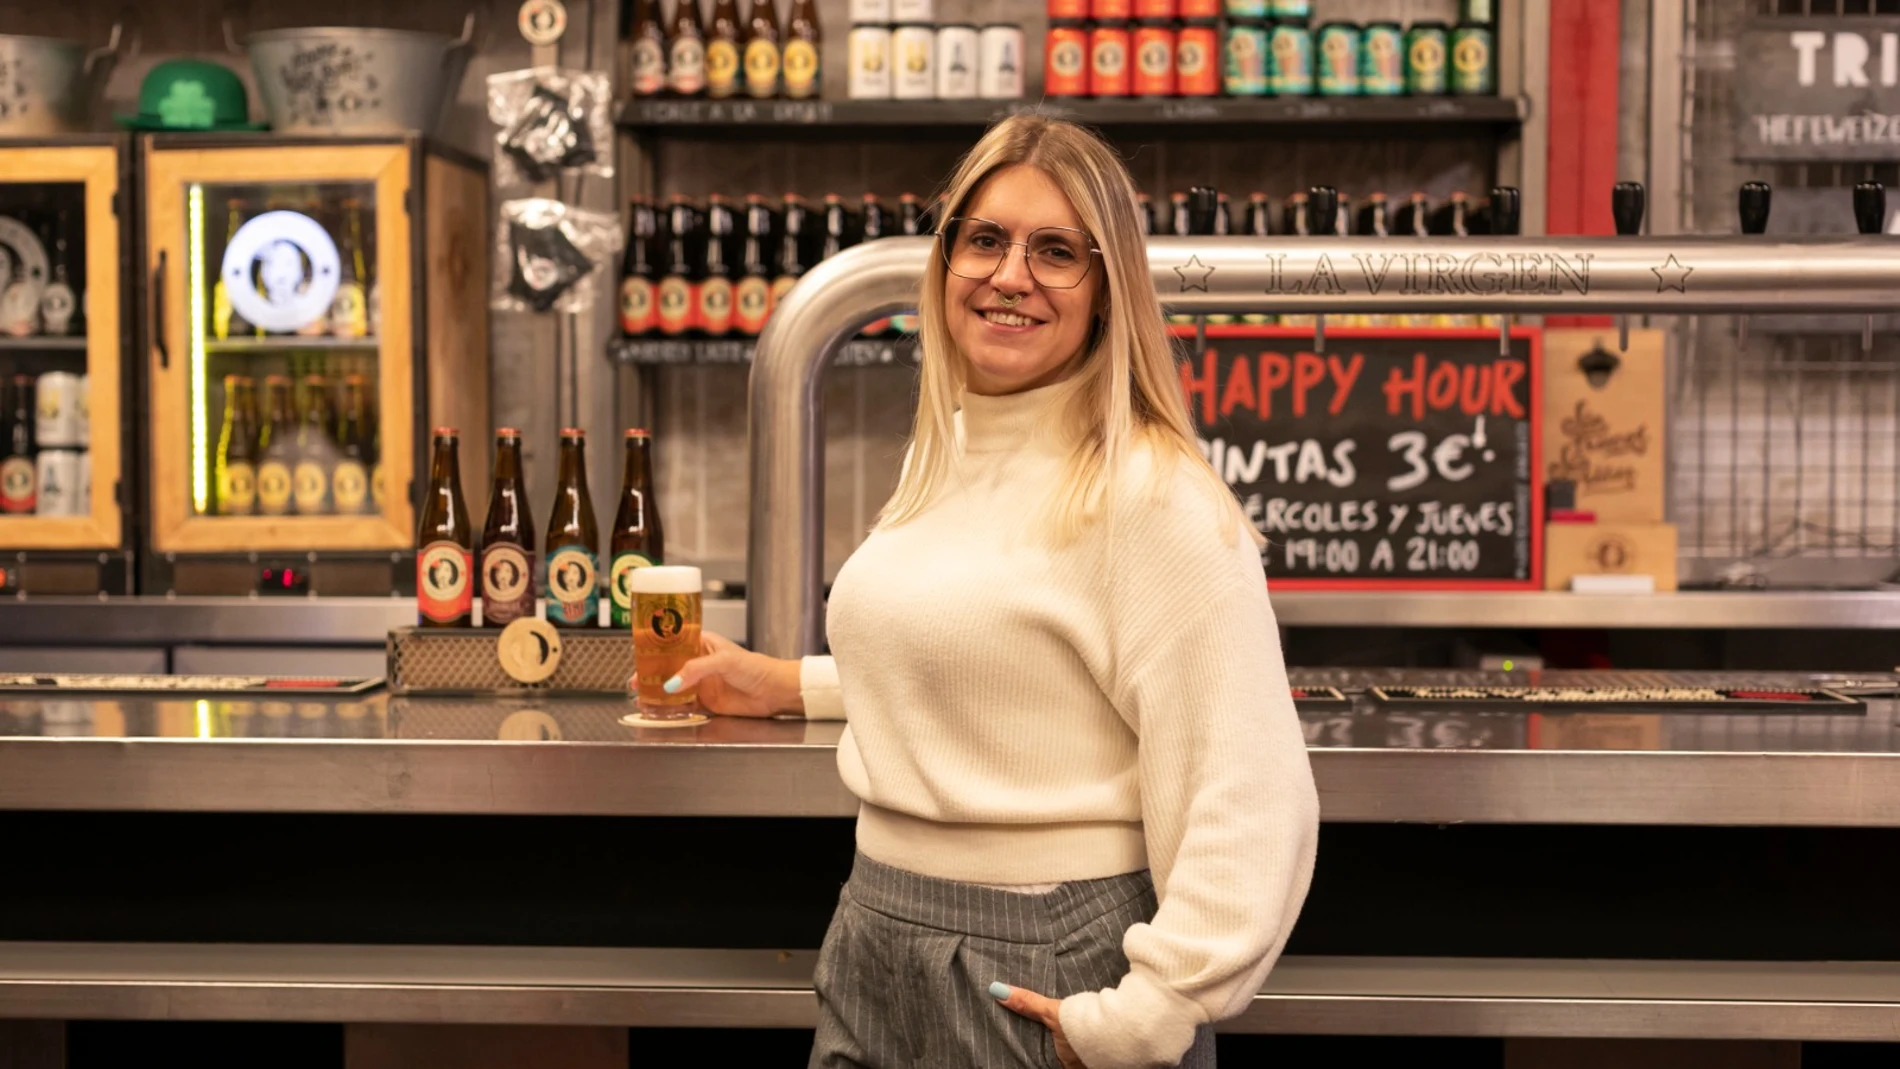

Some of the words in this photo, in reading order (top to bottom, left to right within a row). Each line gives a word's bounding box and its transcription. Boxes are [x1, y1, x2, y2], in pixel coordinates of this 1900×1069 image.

[1791, 31, 1899, 87] TRI
[1264, 252, 1346, 295] LA
[1351, 252, 1596, 295] VIRGEN
[1180, 349, 1365, 425] HAPPY
[1382, 353, 1526, 420] HOUR
[1245, 493, 1378, 534] ÉRCOLES
[1285, 538, 1360, 573] 19:00
[1370, 538, 1394, 571] A
[1406, 538, 1480, 572] 21:00
